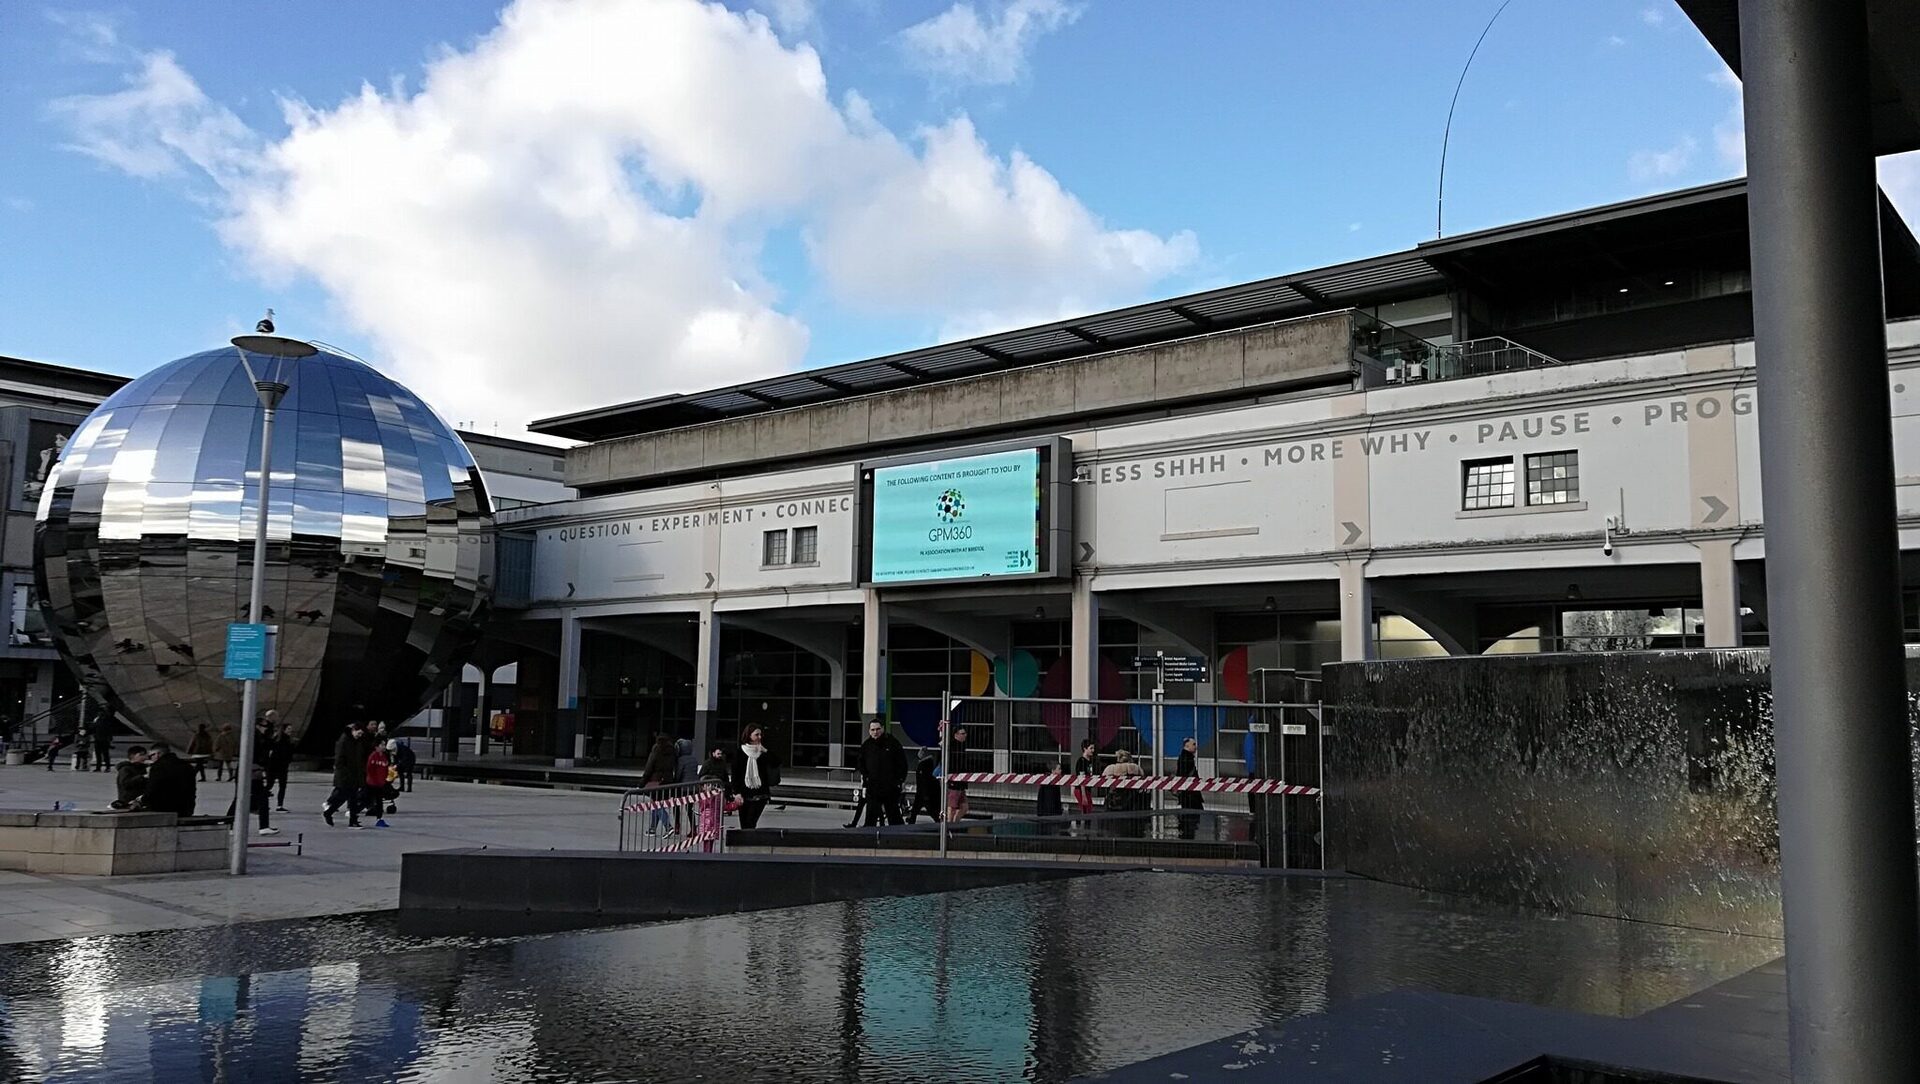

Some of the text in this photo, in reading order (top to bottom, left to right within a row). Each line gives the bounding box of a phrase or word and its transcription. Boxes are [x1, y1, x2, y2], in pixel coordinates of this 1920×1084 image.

[1154, 454, 1226, 478] SHHH
[1264, 440, 1344, 466] MORE
[1360, 430, 1431, 456] WHY
[1478, 411, 1590, 443] PAUSE
[1644, 393, 1752, 426] PROG
[897, 475, 929, 486] FOLLOWING
[930, 472, 955, 482] CONTENT
[962, 469, 990, 478] BROUGHT
[1000, 465, 1012, 473] YOU
[1013, 464, 1021, 472] BY
[559, 497, 850, 543] QUESTION EXPERIMENT CONNEC
[928, 525, 973, 542] GPM360
